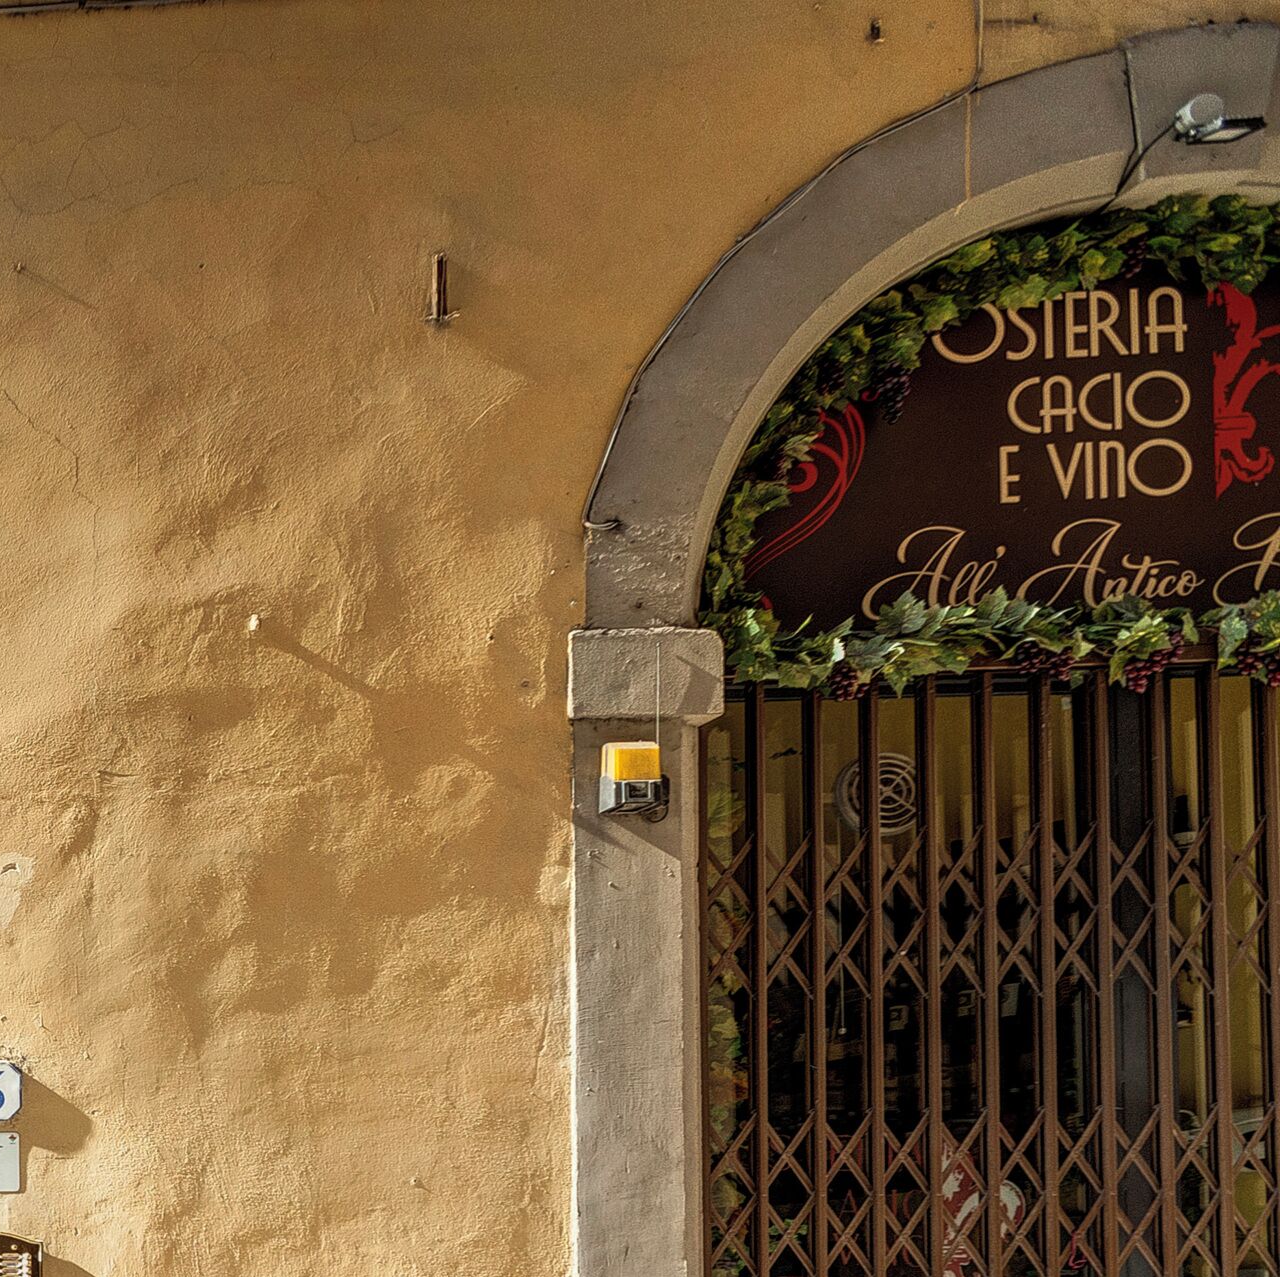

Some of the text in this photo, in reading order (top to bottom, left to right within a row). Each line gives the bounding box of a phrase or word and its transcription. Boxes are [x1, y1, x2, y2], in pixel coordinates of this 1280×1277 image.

[931, 287, 1188, 364] OSTERIA
[1007, 370, 1191, 434] CACIO
[999, 438, 1193, 504] E VINO
[1016, 517, 1205, 609] Antico
